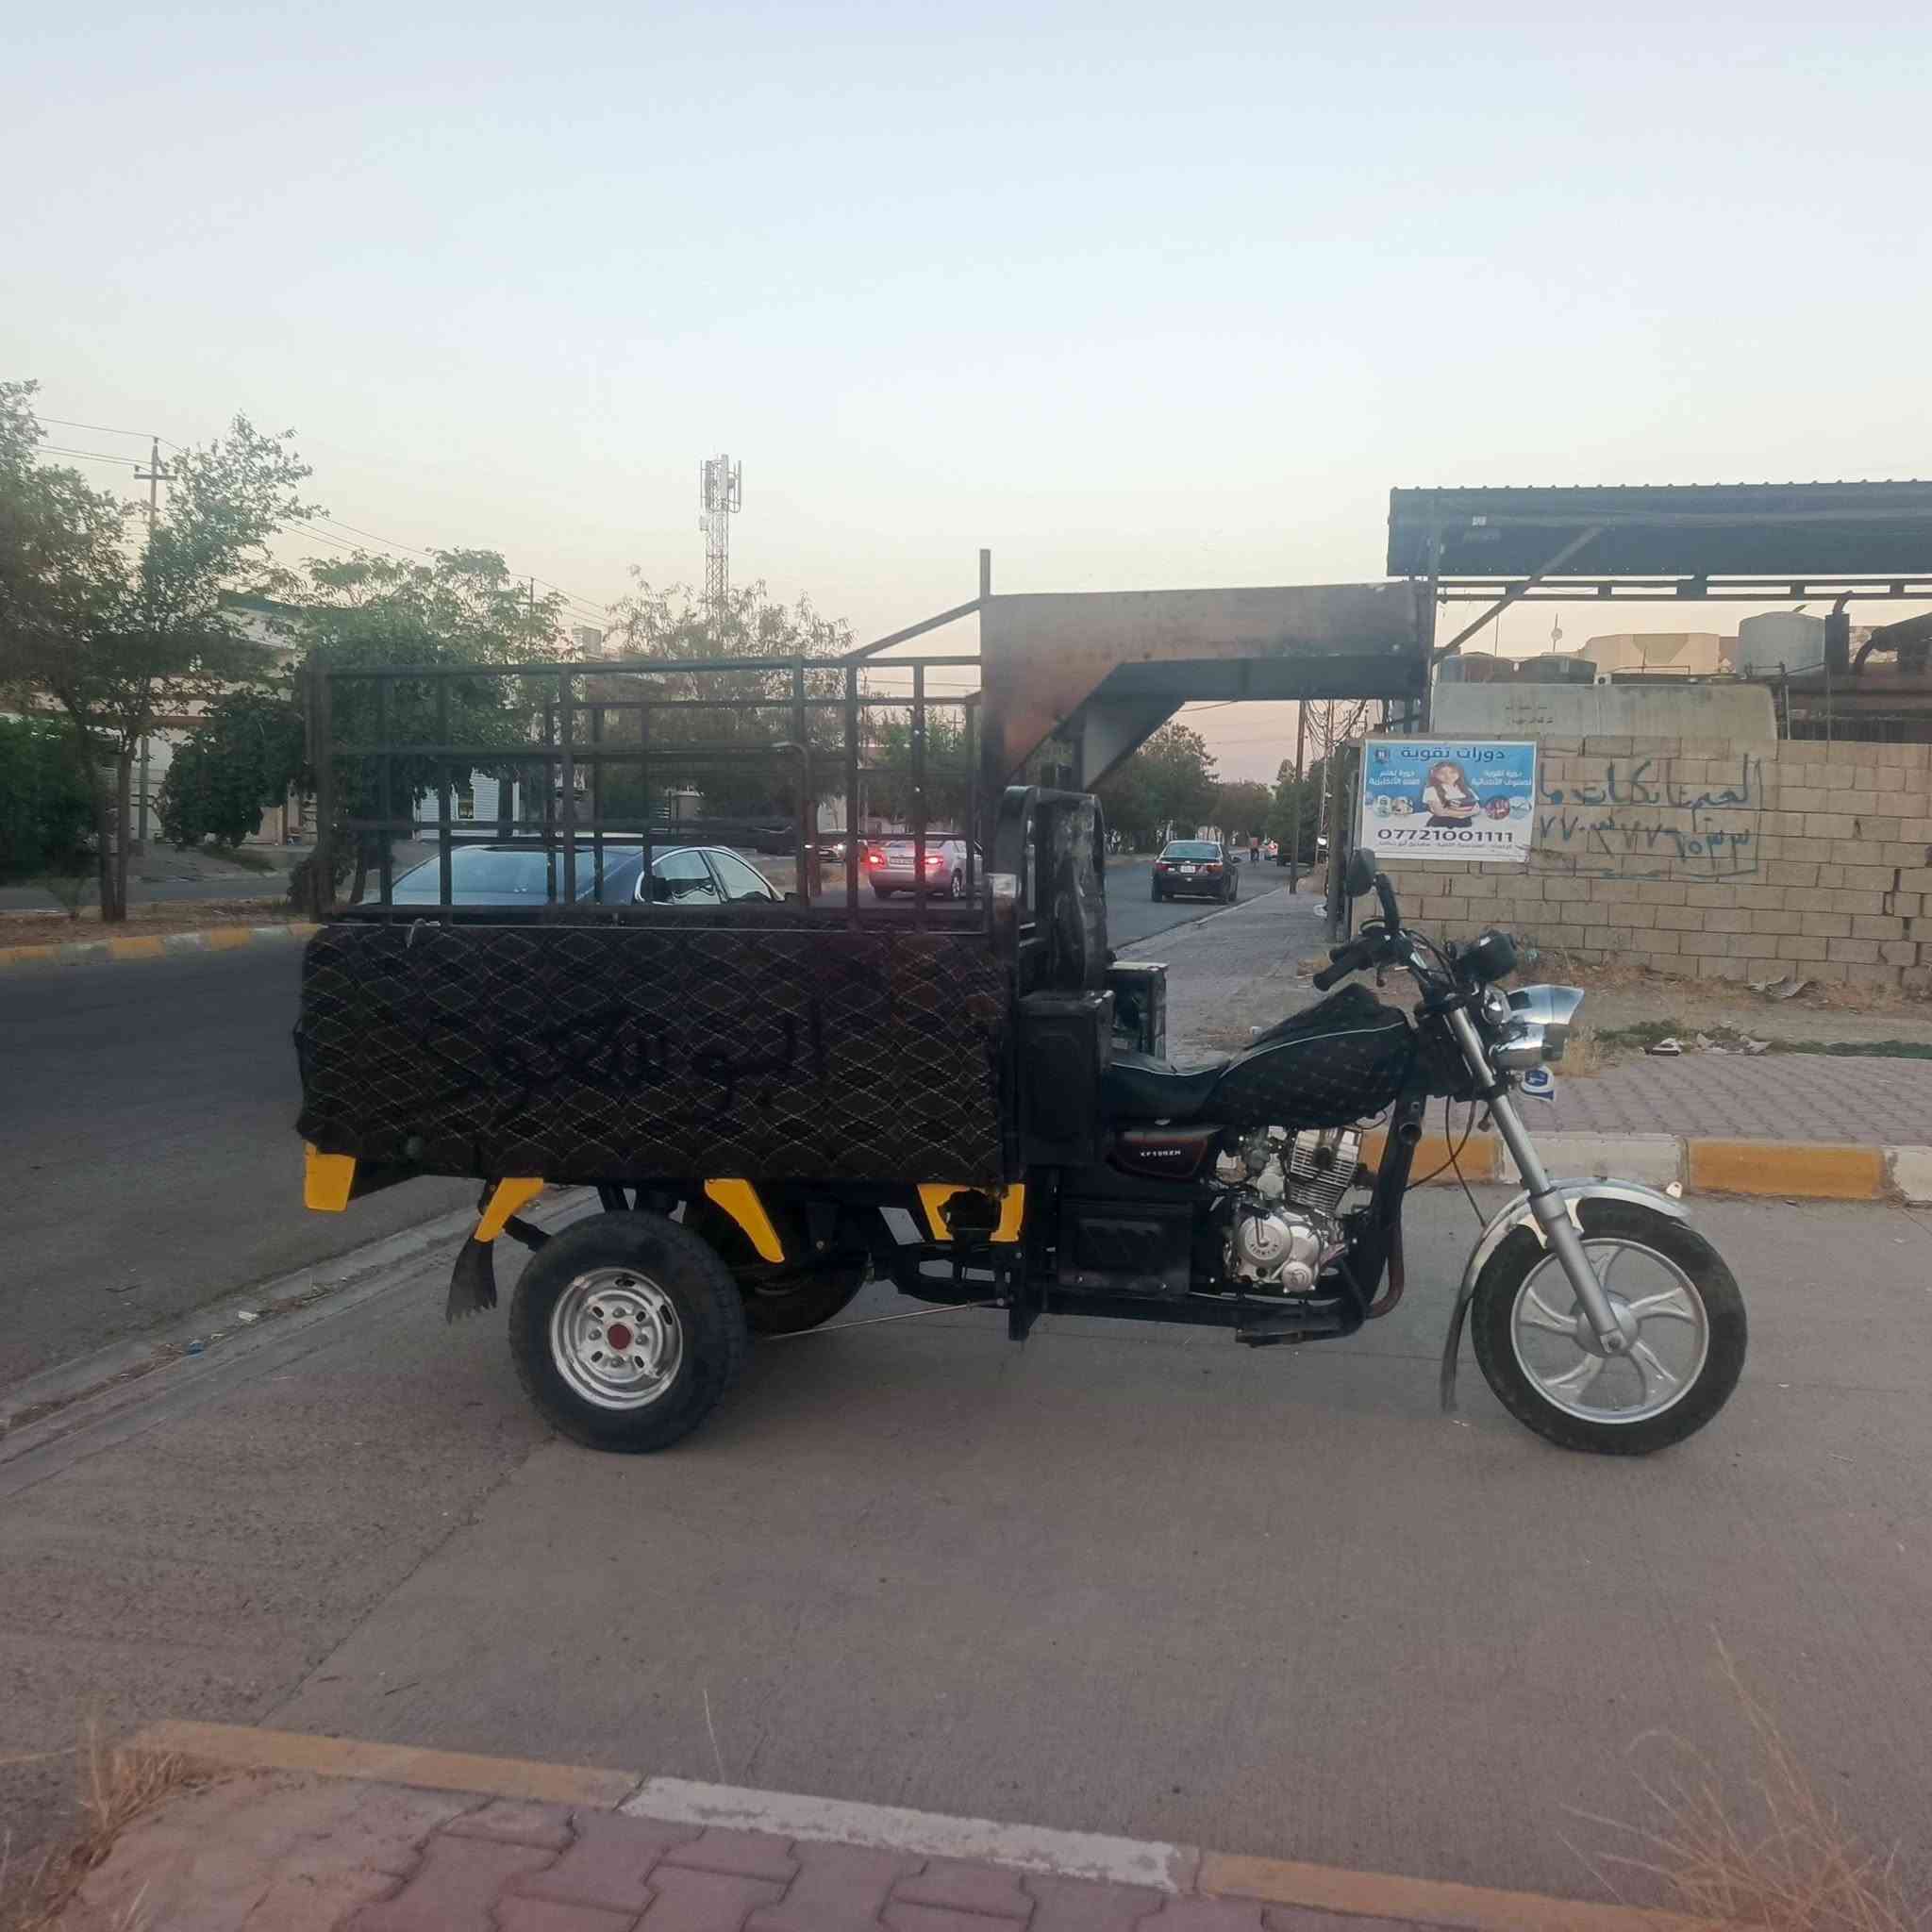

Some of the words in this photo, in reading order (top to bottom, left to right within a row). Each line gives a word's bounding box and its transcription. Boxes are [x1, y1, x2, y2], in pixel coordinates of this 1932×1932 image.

[1401, 747, 1450, 762] تقوية
[1457, 747, 1505, 762] دورات
[1377, 828, 1513, 842] 07721001111
